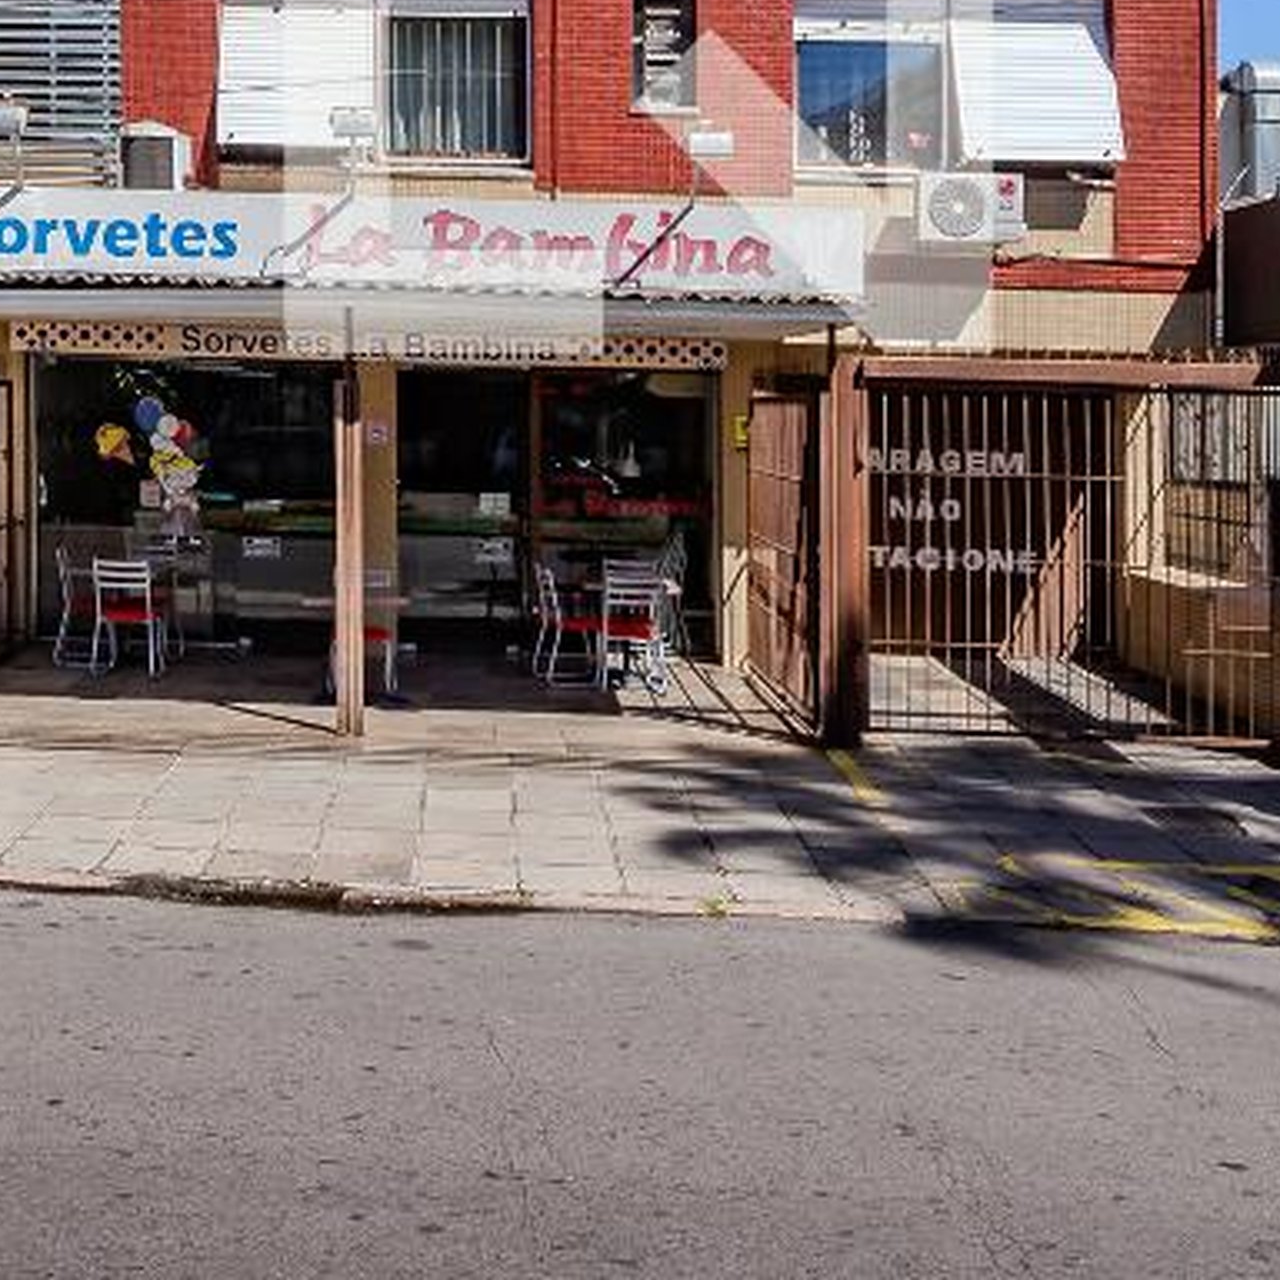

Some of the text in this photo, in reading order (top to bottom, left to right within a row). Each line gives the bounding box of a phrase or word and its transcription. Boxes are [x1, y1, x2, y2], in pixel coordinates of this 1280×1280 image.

[424, 208, 774, 280] Bambina
[180, 323, 331, 357] Sorvetes
[405, 332, 556, 361] Bambina
[869, 448, 1025, 477] ARAGEM
[888, 486, 961, 521] NÃO
[867, 544, 1037, 573] TACIONE
